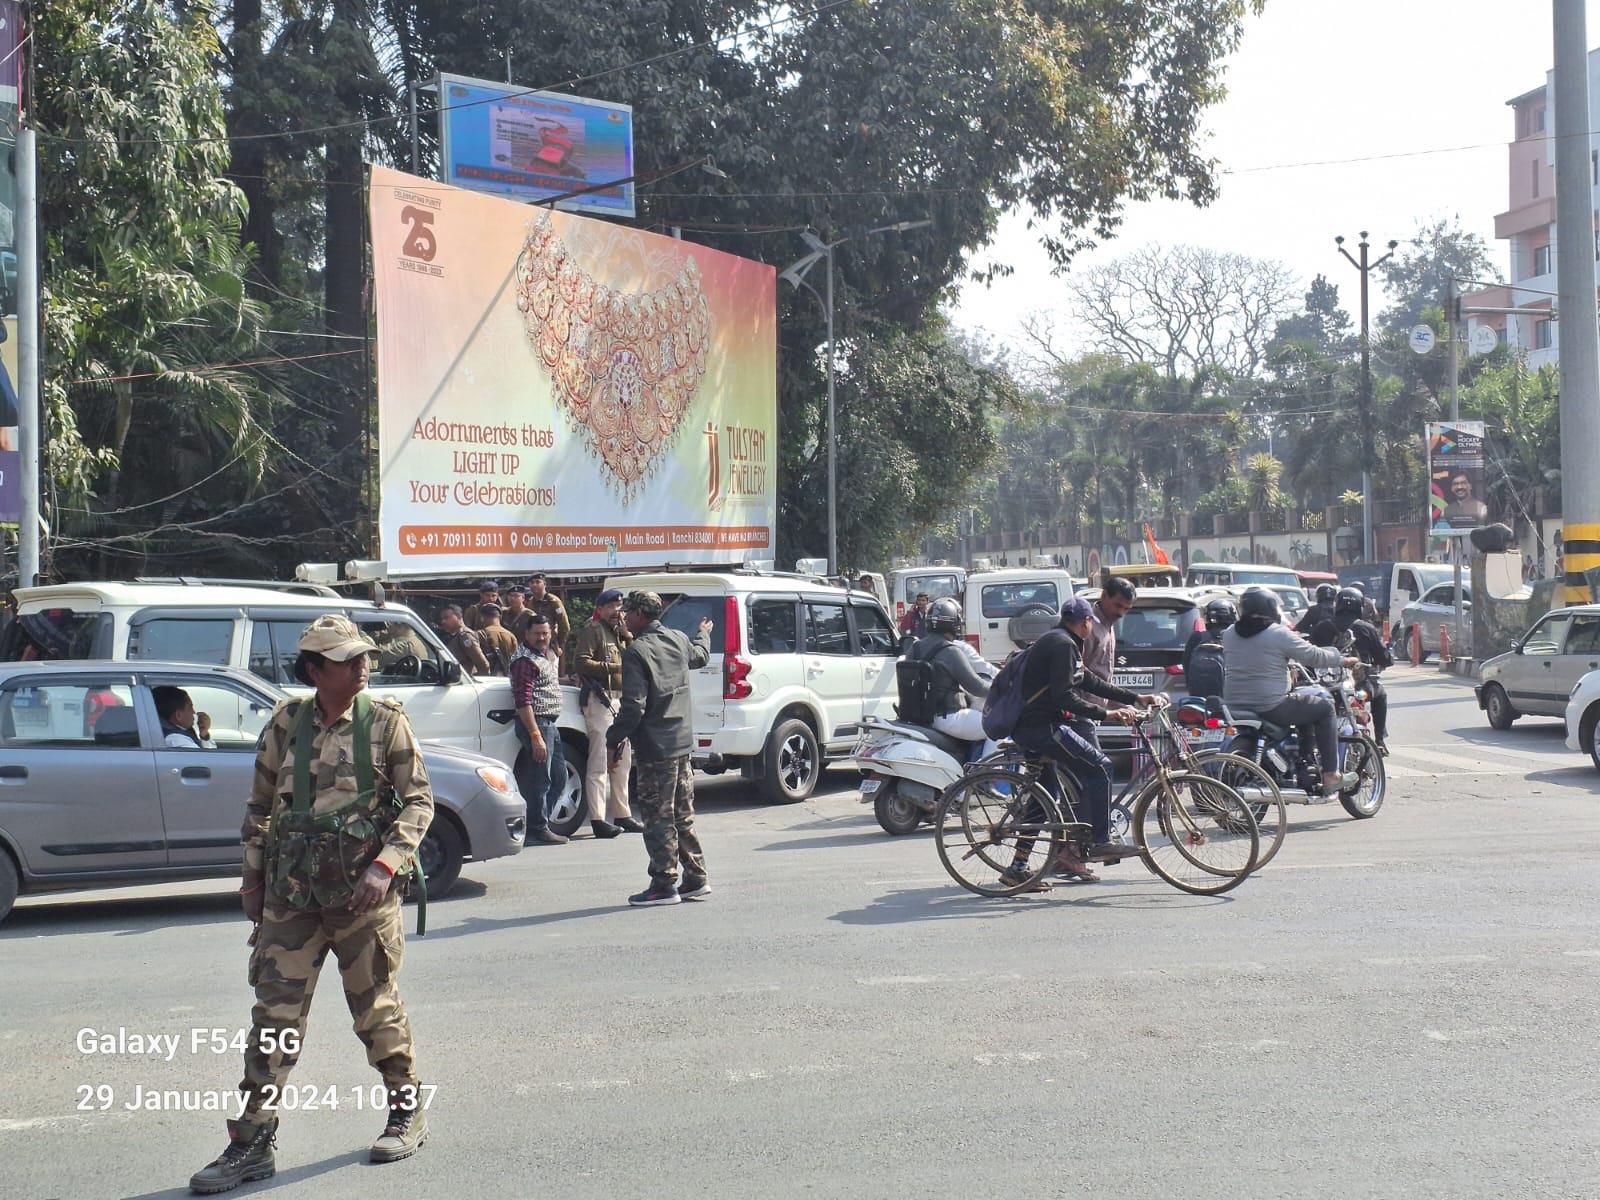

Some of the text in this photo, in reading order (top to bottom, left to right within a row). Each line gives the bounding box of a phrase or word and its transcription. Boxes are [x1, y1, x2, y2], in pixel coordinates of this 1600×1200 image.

[401, 205, 436, 262] 25
[411, 416, 554, 449] Adornments that
[726, 426, 766, 462] TULSYAN
[453, 451, 520, 475] LIGHT UP
[727, 463, 766, 495] JEWELLERY
[409, 480, 556, 507] Your Celebrations!
[420, 533, 438, 547] +91
[443, 533, 472, 547] 70911
[475, 533, 503, 547] 50111
[522, 533, 544, 549] Only
[546, 534, 554, 546] @
[555, 533, 587, 549] Roshpa
[588, 533, 617, 546] Towers
[625, 533, 645, 545] Main
[646, 532, 665, 545] Road
[672, 532, 694, 545] Ranchi
